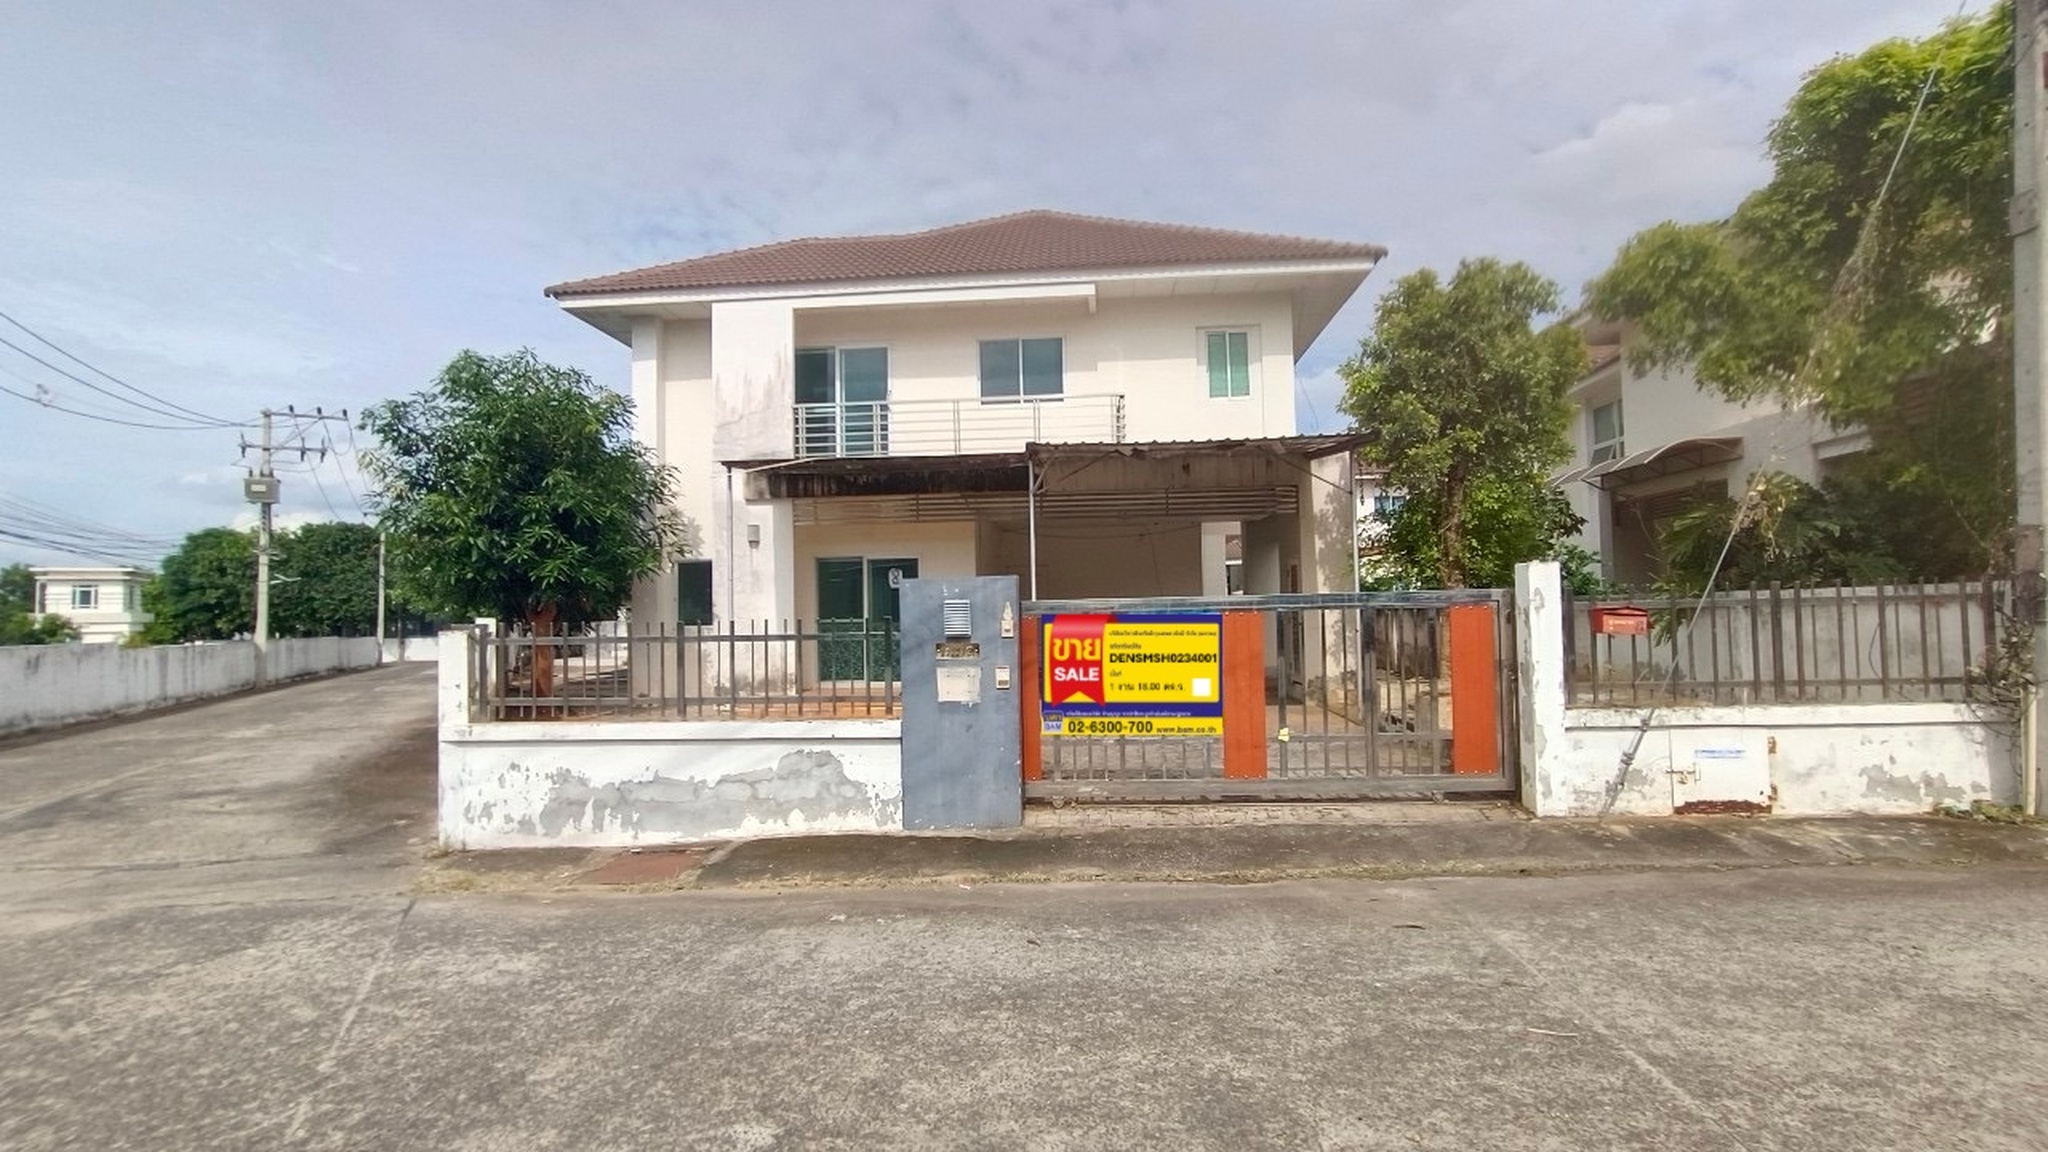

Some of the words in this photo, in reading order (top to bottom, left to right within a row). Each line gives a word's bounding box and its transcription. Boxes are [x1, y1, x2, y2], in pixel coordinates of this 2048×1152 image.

[1053, 638, 1101, 661] ขาย
[1109, 653, 1217, 663] DENSMSH0234001
[1054, 667, 1100, 681] SALE
[1068, 720, 1153, 733] 02-6300-700
[1156, 725, 1217, 734] www.bam.co.th
